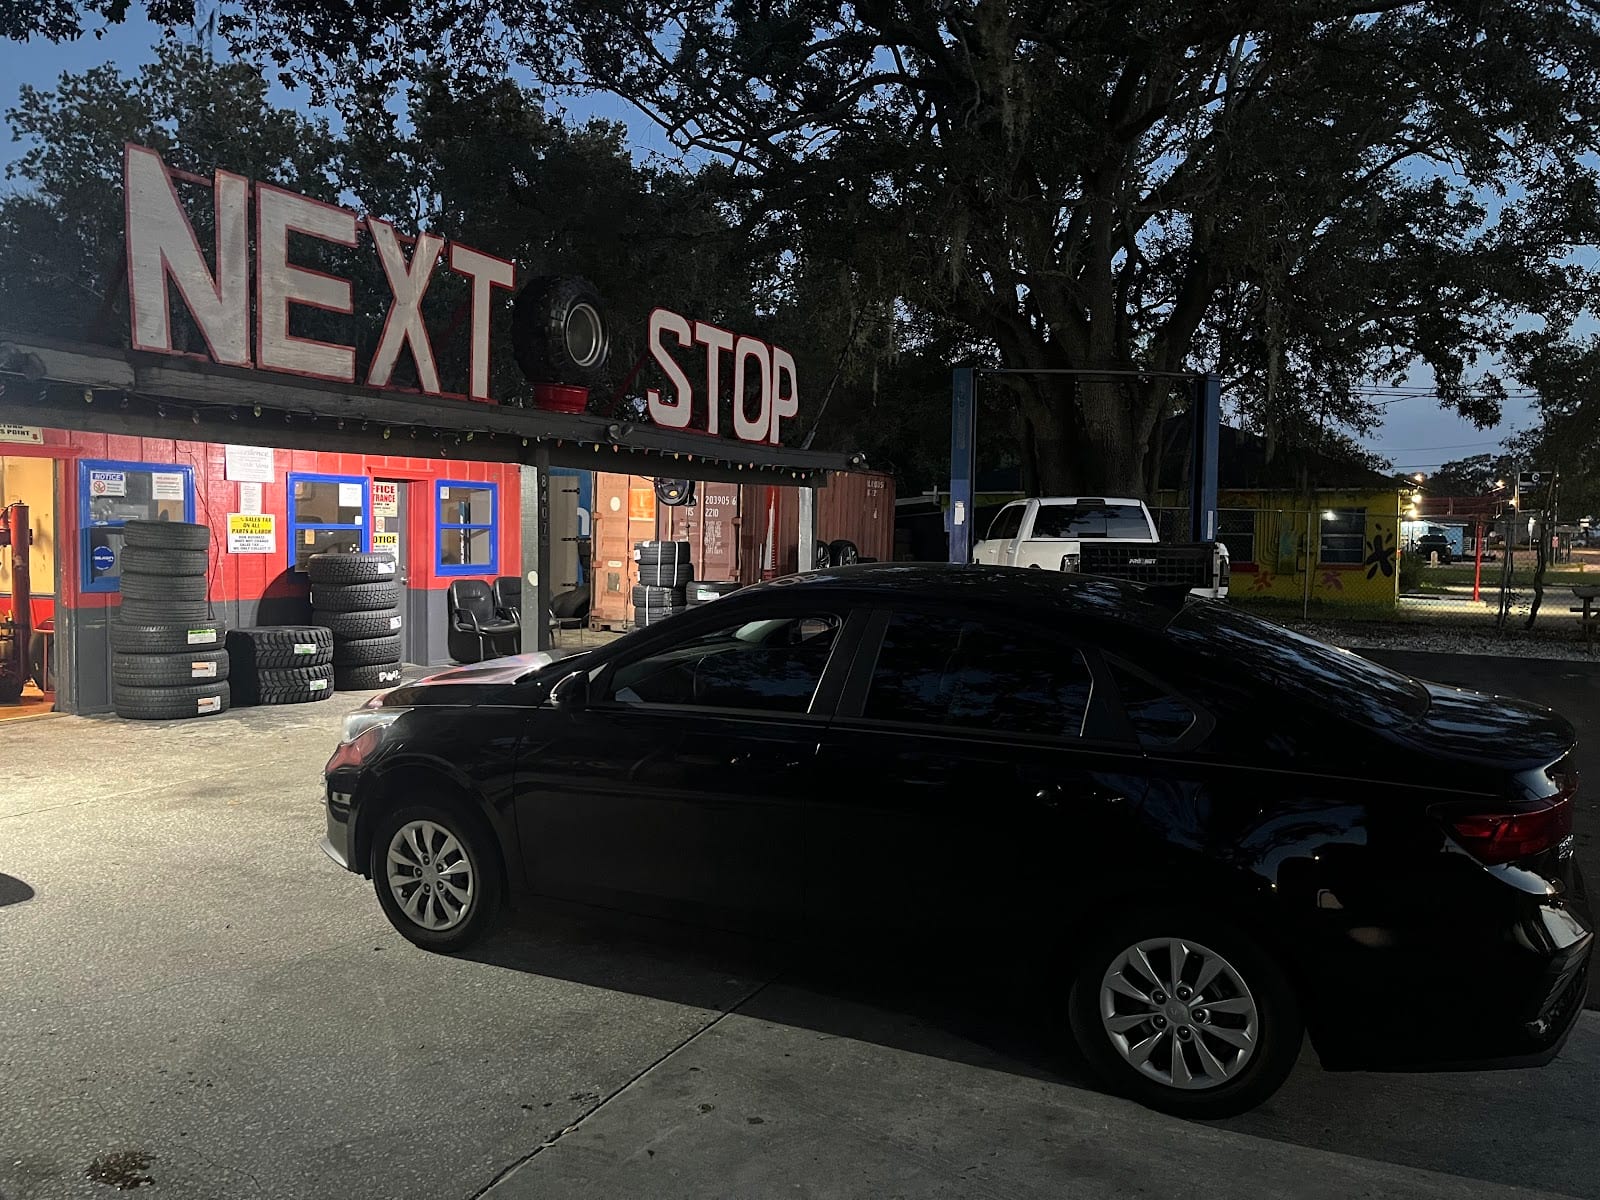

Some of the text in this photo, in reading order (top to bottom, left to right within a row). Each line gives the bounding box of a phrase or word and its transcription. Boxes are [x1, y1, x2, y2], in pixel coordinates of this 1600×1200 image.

[124, 142, 799, 445] NEXT STOP
[705, 495, 730, 505] 203905
[705, 508, 719, 517] 2210
